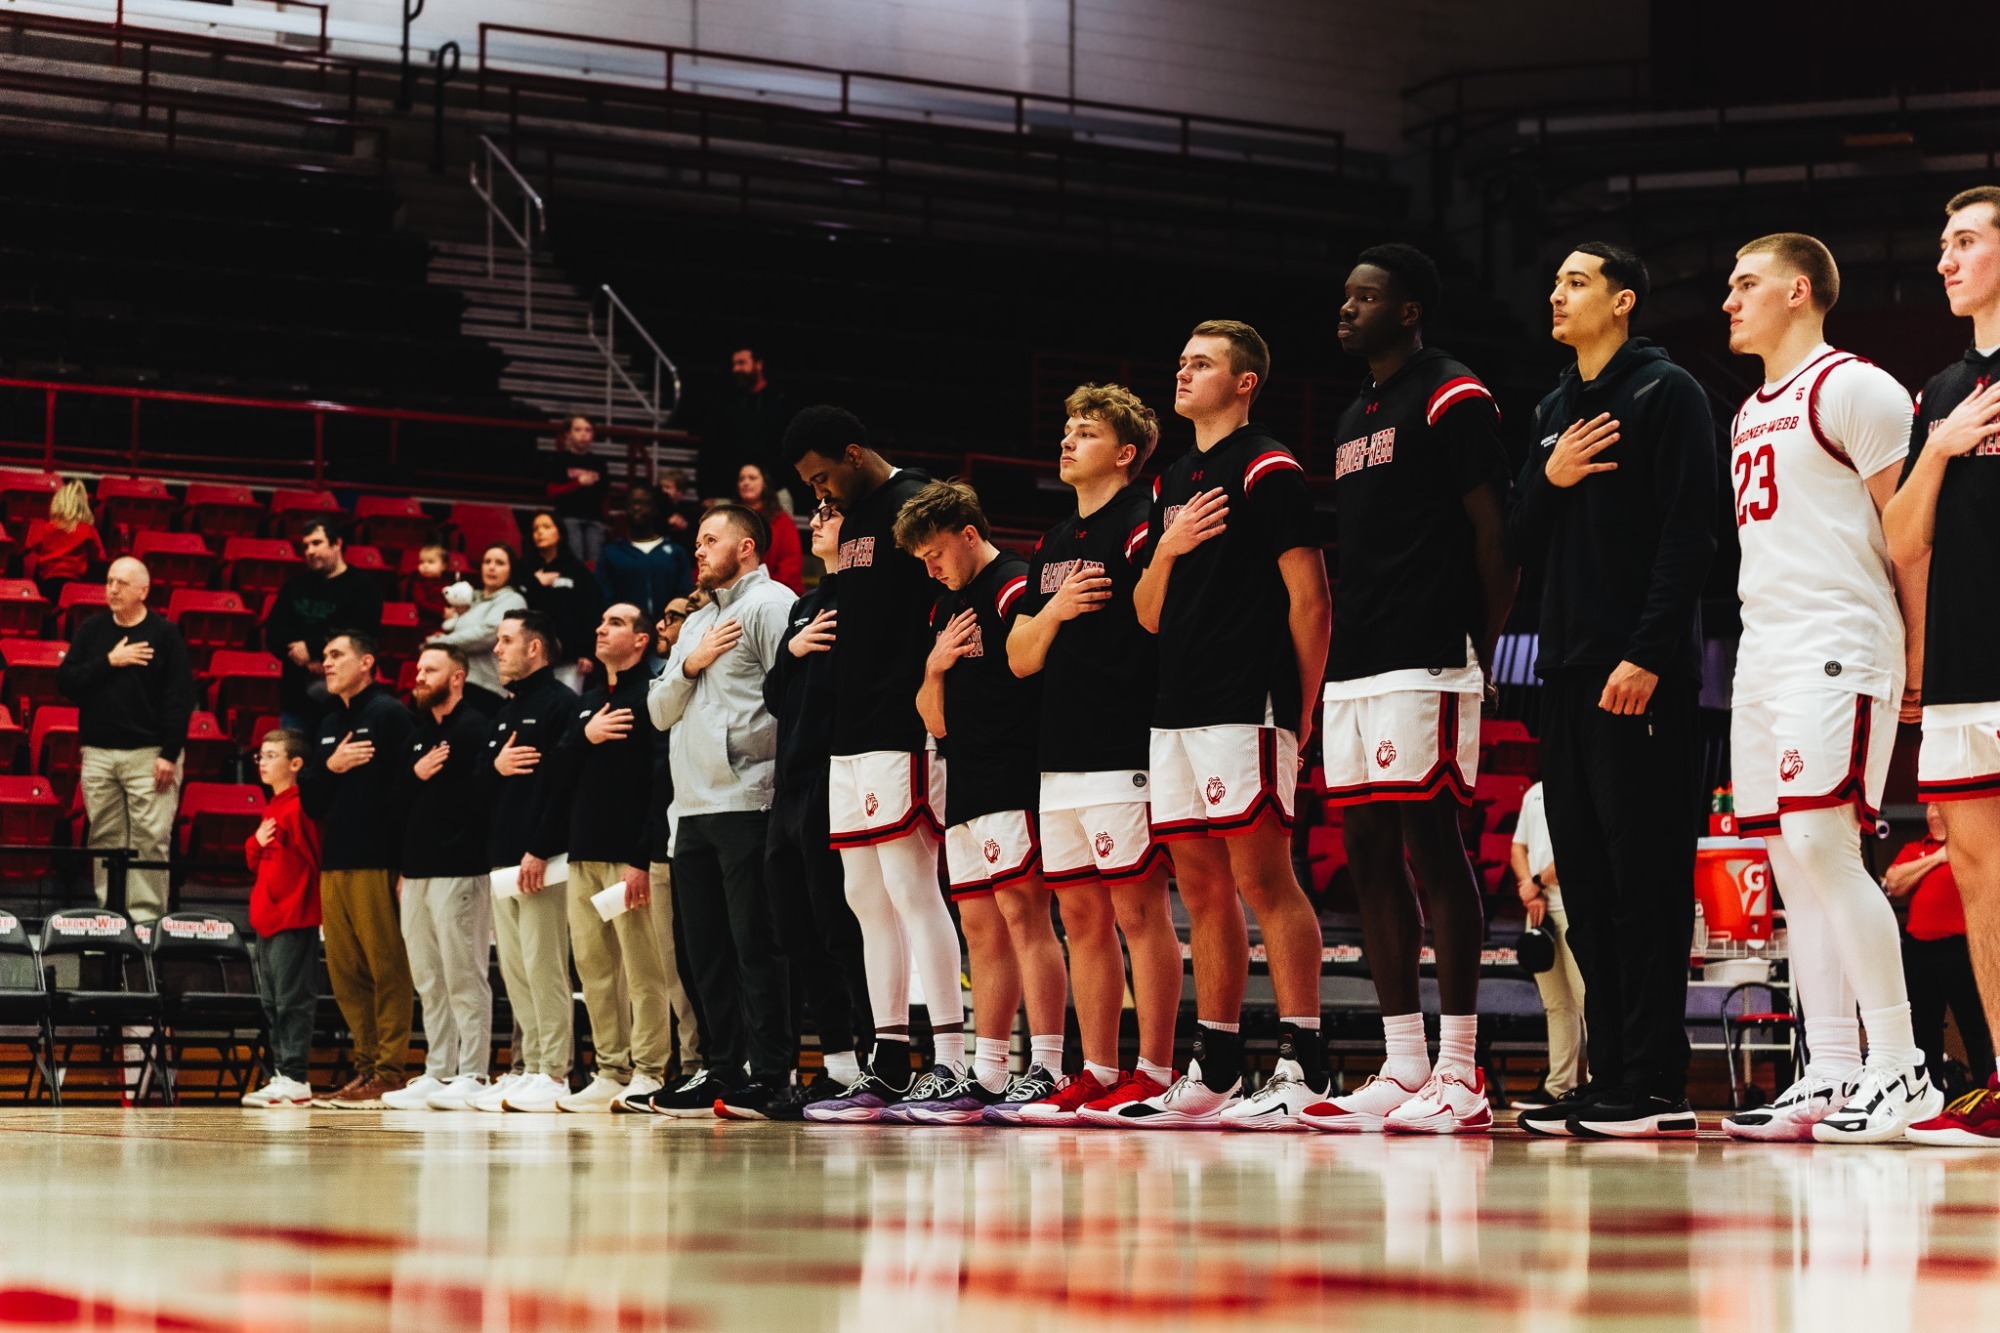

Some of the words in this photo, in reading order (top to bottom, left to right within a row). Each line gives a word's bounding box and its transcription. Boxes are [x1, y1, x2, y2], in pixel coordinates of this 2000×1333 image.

[1735, 444, 1779, 528] 23
[1720, 816, 1732, 833] G
[1744, 864, 1765, 891] G
